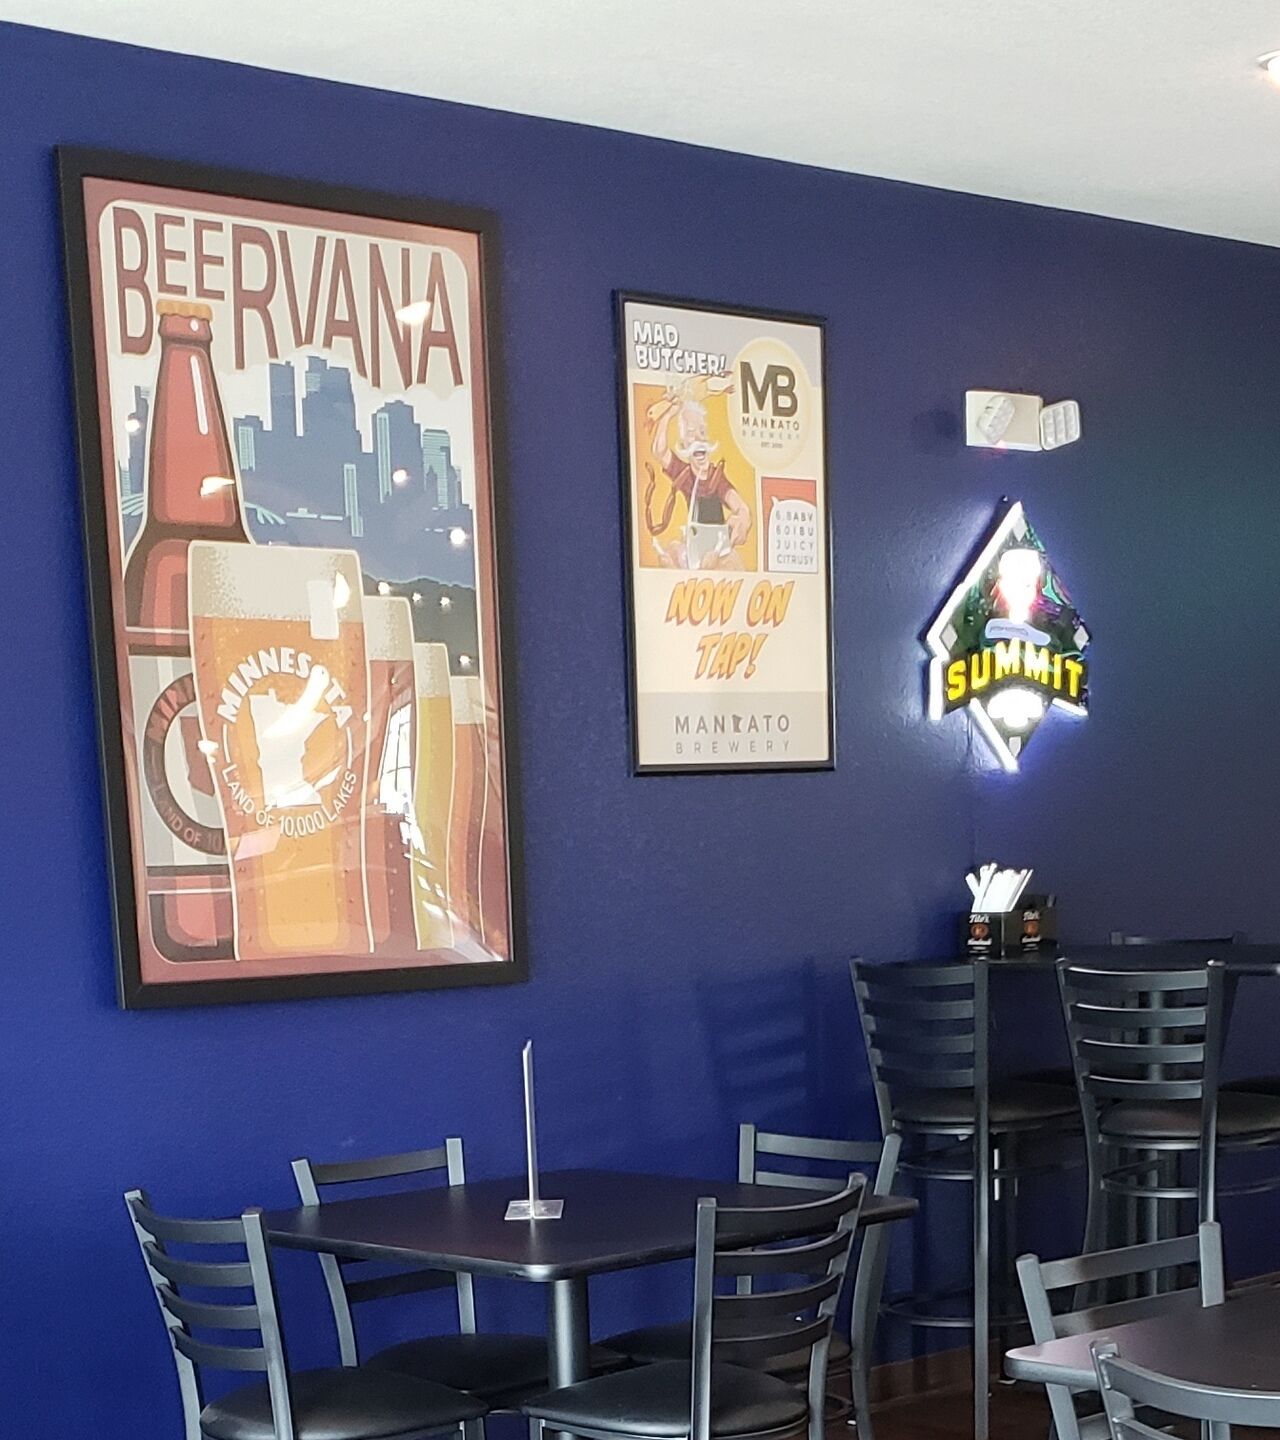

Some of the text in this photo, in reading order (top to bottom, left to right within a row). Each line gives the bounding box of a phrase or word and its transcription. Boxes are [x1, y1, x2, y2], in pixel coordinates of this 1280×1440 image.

[113, 206, 463, 390] BEERVANA
[633, 321, 679, 349] MAD
[635, 344, 726, 378] BUTCHER!
[740, 362, 798, 417] MB
[776, 540, 813, 551] JUICY
[777, 554, 813, 565] CITRUSY
[664, 578, 795, 628] NOW ON
[695, 632, 768, 680] TAP!
[947, 637, 1084, 701] SUMMIT
[676, 740, 790, 754] BREWERY
[222, 763, 356, 838] LAND OF 10,000 LAKES
